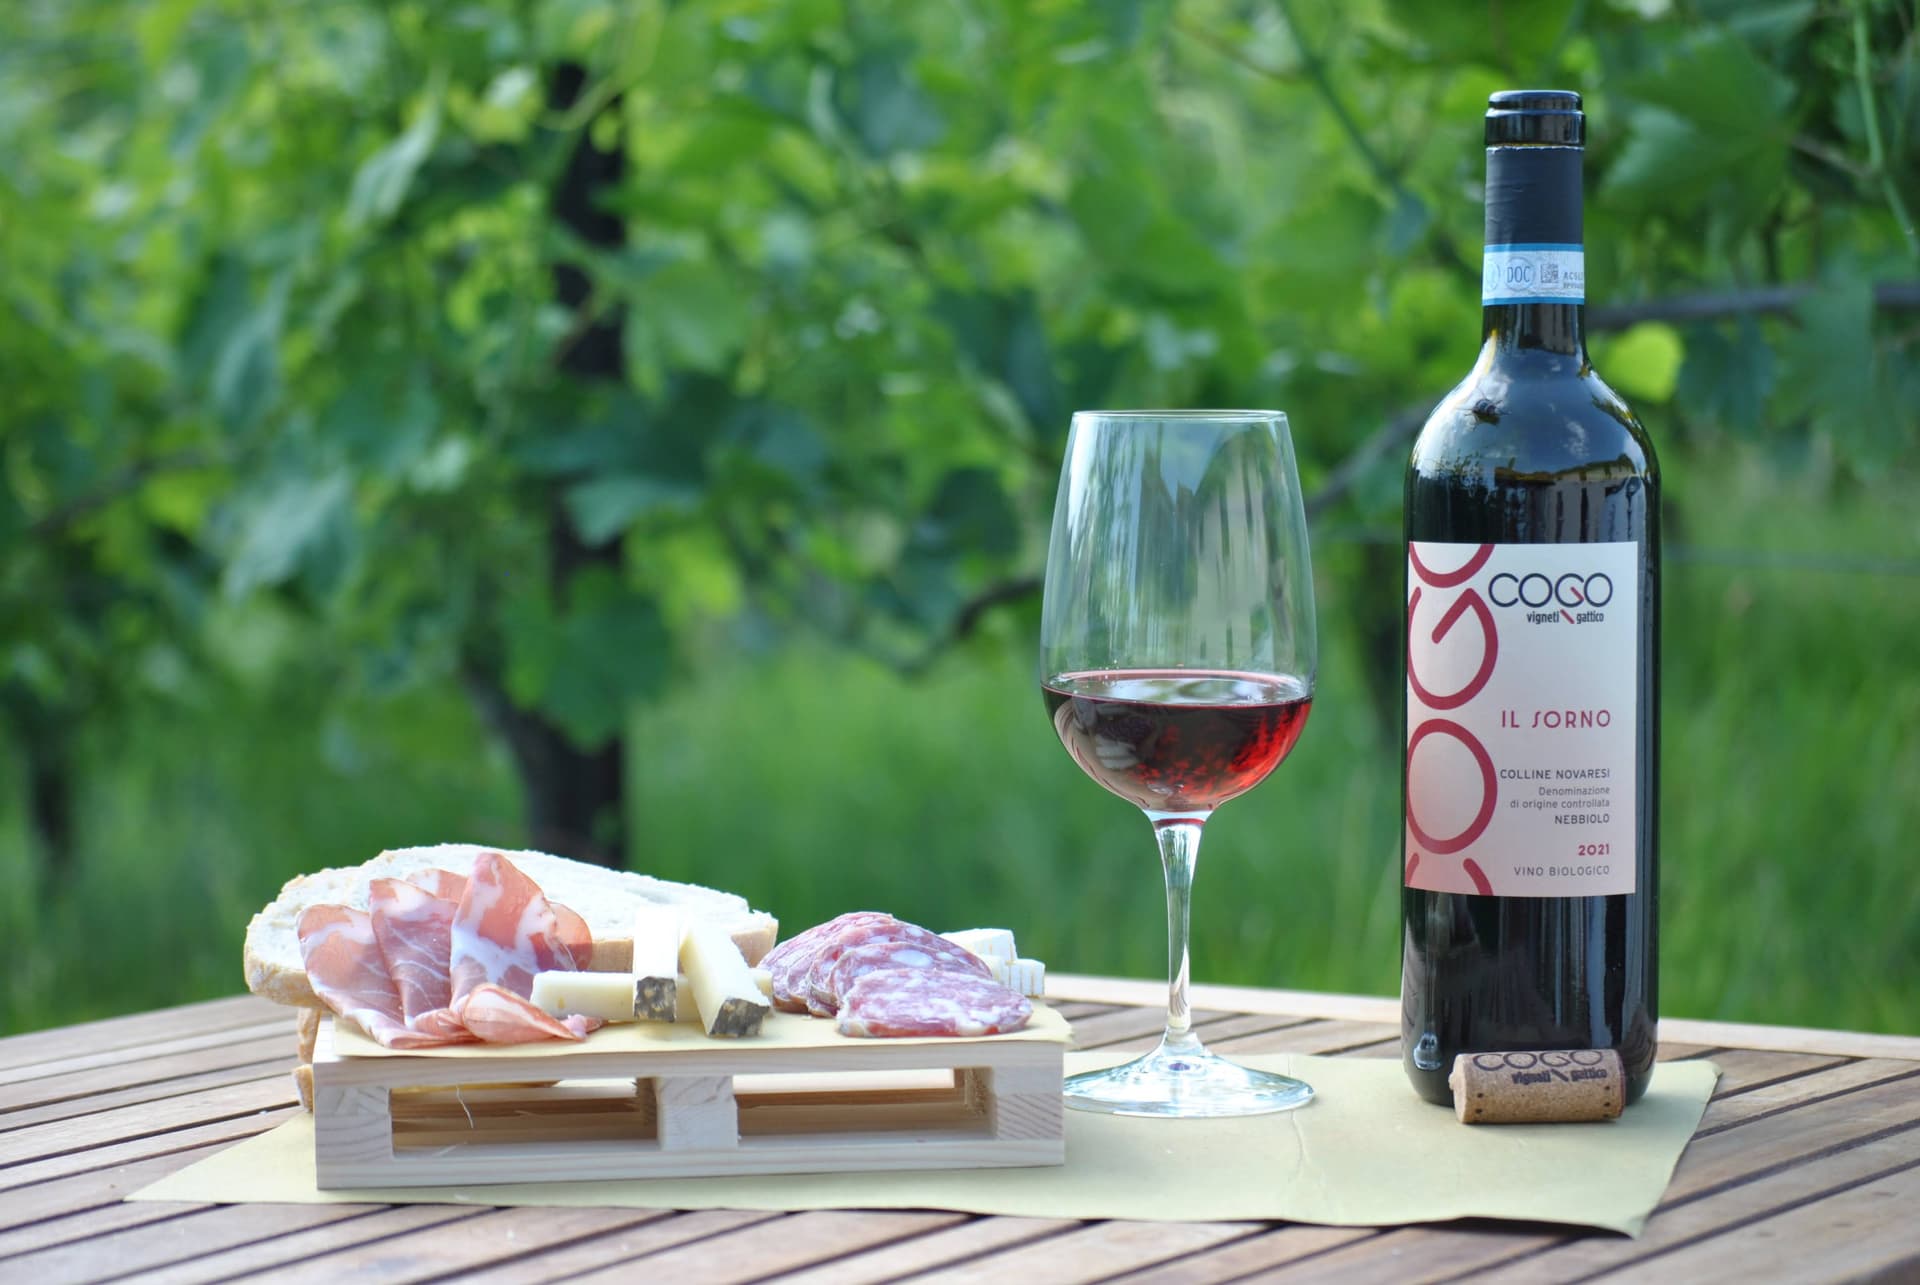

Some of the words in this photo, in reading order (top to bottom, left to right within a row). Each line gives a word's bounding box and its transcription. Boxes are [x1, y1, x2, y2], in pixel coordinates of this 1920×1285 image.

[1507, 266, 1531, 284] DOC
[1488, 572, 1614, 608] COGO
[1526, 611, 1560, 625] vigneti
[1576, 611, 1605, 625] gattico
[1502, 711, 1520, 729] IL
[1532, 710, 1612, 729] SORNO
[1500, 769, 1552, 780] COLLINE
[1556, 768, 1611, 780] NOVARESI
[1538, 785, 1611, 796] Denominazione
[1510, 799, 1520, 809] di
[1522, 799, 1558, 811] origine
[1561, 799, 1610, 809] controllata
[1554, 813, 1610, 825] NEBBIOLO
[1578, 844, 1610, 856] 2021
[1514, 866, 1544, 877] VINO
[1549, 865, 1610, 877] BIOLOGICO
[1473, 1050, 1604, 1072] COGO
[1511, 1070, 1551, 1085] vigneti
